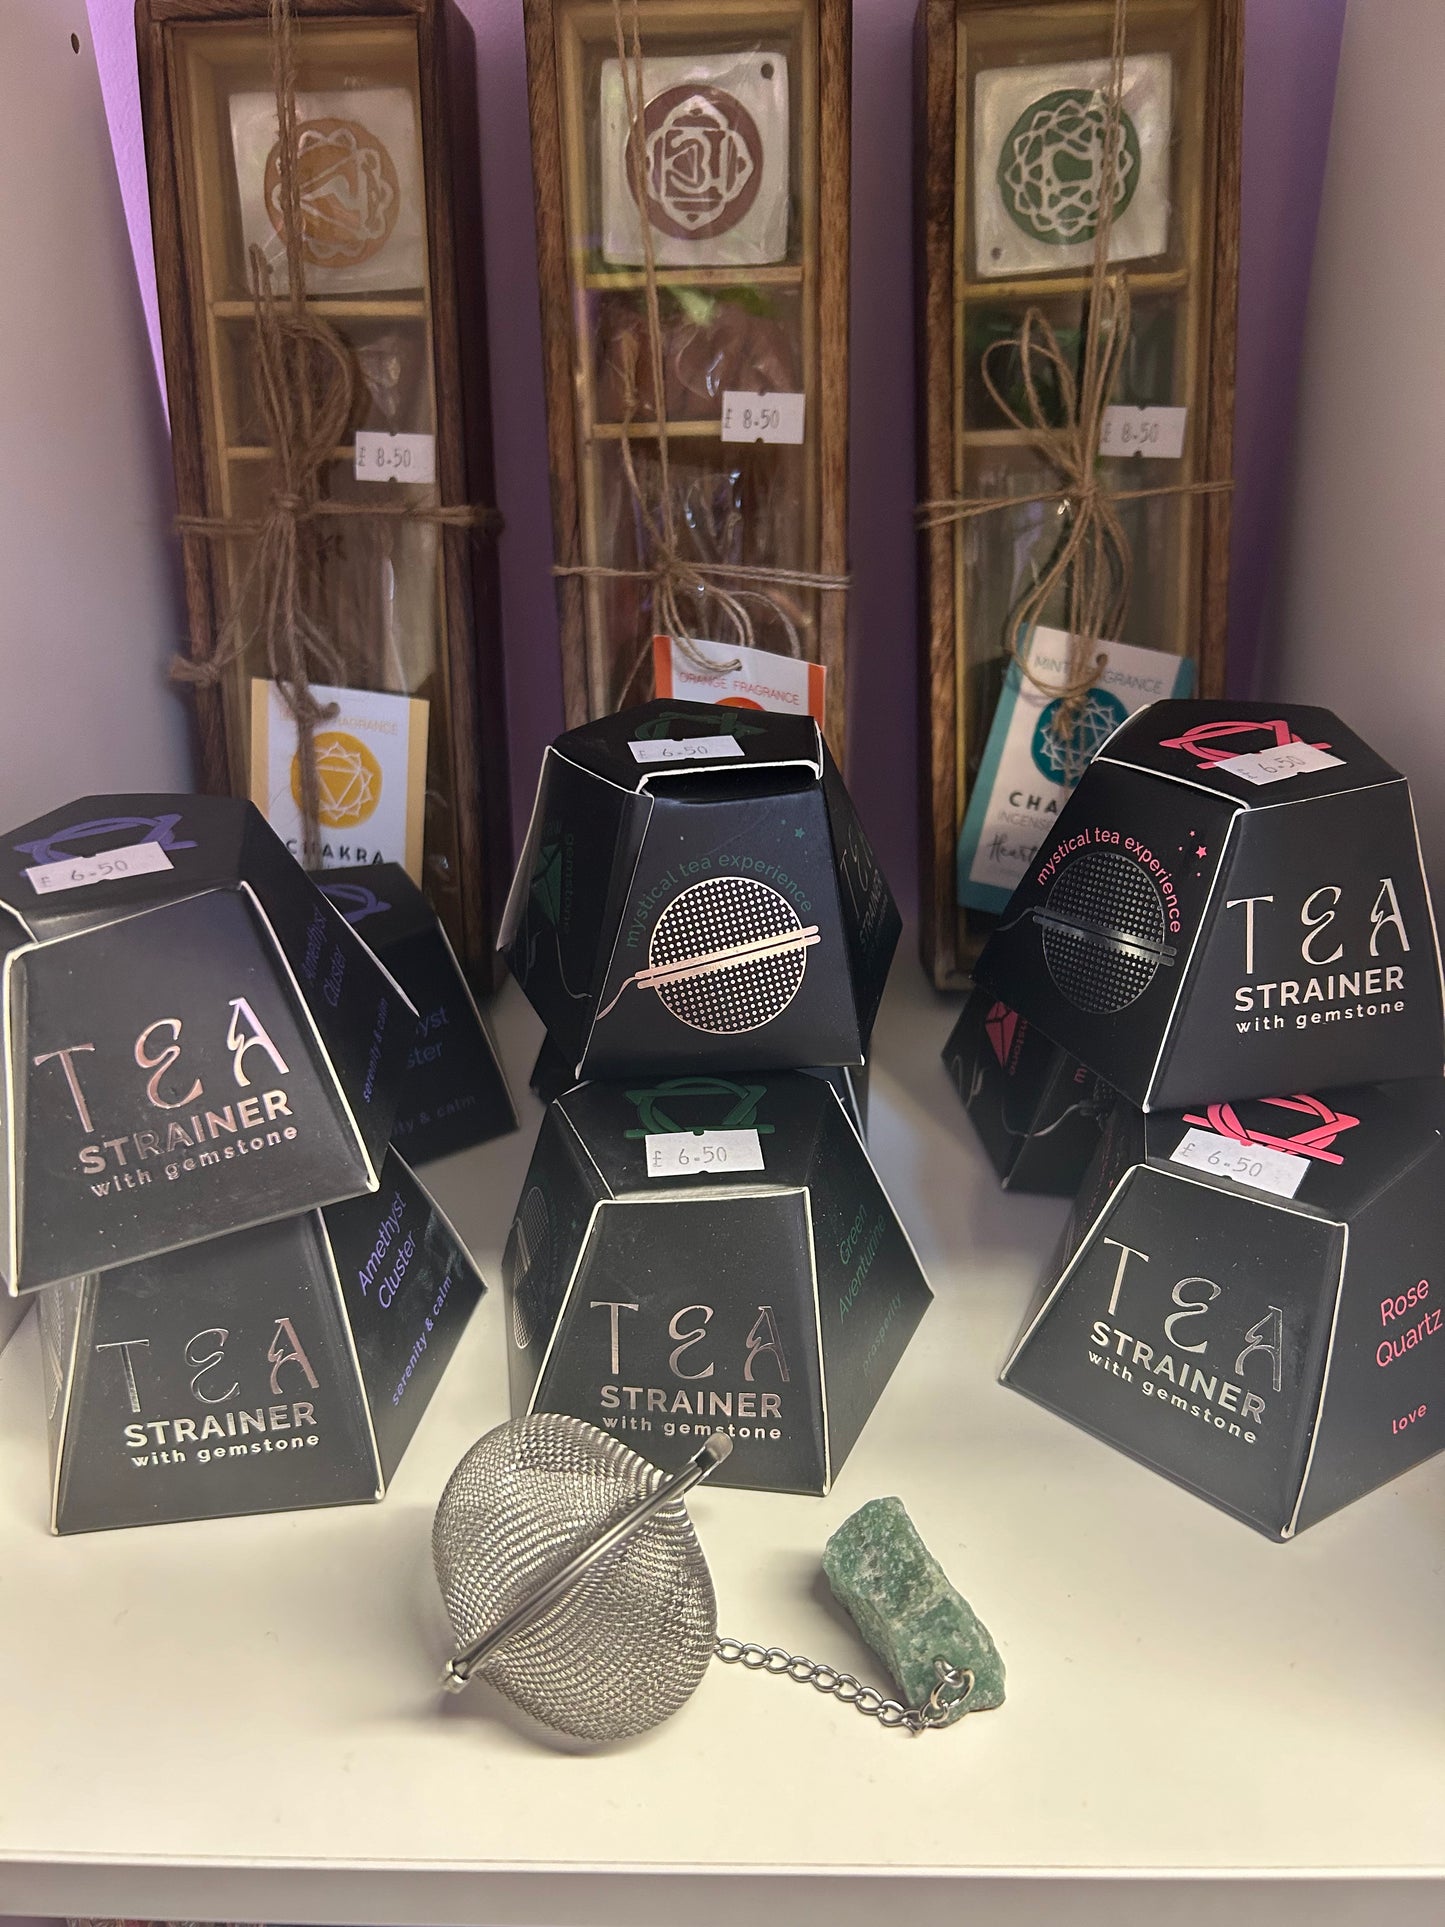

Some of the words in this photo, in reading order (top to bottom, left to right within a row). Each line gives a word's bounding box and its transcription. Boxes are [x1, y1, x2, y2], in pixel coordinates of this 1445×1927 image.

[743, 408, 780, 430] 8.50
[376, 447, 411, 468] 8.50
[678, 671, 728, 690] ORANGE
[733, 680, 801, 706] FRAGRANCE
[662, 745, 708, 758] 6.50
[1258, 755, 1306, 774] 6.50
[1008, 790, 1058, 814] CHA
[71, 860, 128, 881] 6.50
[625, 868, 677, 949] mystical
[679, 855, 712, 878] tea
[718, 853, 812, 913] experience
[1037, 828, 1092, 886] mystical
[1095, 826, 1120, 845] tea
[1124, 837, 1181, 933] experience
[1227, 878, 1411, 974] TEA
[323, 943, 347, 1007] Cluster
[1234, 966, 1405, 1012] STRAINER
[1236, 1014, 1285, 1035] with
[1296, 1000, 1406, 1029] gemstone
[33, 997, 290, 1133] TEA
[78, 1089, 293, 1175] STRAINER
[90, 1165, 153, 1198] with
[164, 1123, 299, 1180] gemstone
[652, 1150, 662, 1167] £
[678, 1146, 727, 1165] 6.50
[1181, 1142, 1195, 1157] £
[1207, 1150, 1263, 1177] 6.50
[357, 1192, 407, 1298] Amethyst
[839, 1203, 868, 1266] Green
[378, 1229, 418, 1310] Cluster
[837, 1213, 887, 1325] Aventurine
[1103, 1237, 1282, 1392] TEA
[1380, 1279, 1429, 1327] Rose
[97, 1317, 320, 1413] TEA
[391, 1337, 428, 1407] serenity
[422, 1317, 436, 1333] &
[432, 1274, 454, 1317] calm
[590, 1301, 790, 1382] TEA
[862, 1293, 904, 1378] prosperity
[1375, 1308, 1443, 1367] Quartz
[600, 1384, 783, 1418] STRAINER
[1088, 1350, 1133, 1382] with
[1141, 1378, 1258, 1444] gemstone
[1089, 1321, 1266, 1426] STRAINER
[123, 1401, 317, 1448] STRAINER
[131, 1448, 186, 1468] with
[196, 1432, 320, 1463] gemstone
[602, 1415, 652, 1431] with
[663, 1421, 782, 1440] gemstone
[1391, 1404, 1427, 1435] love
